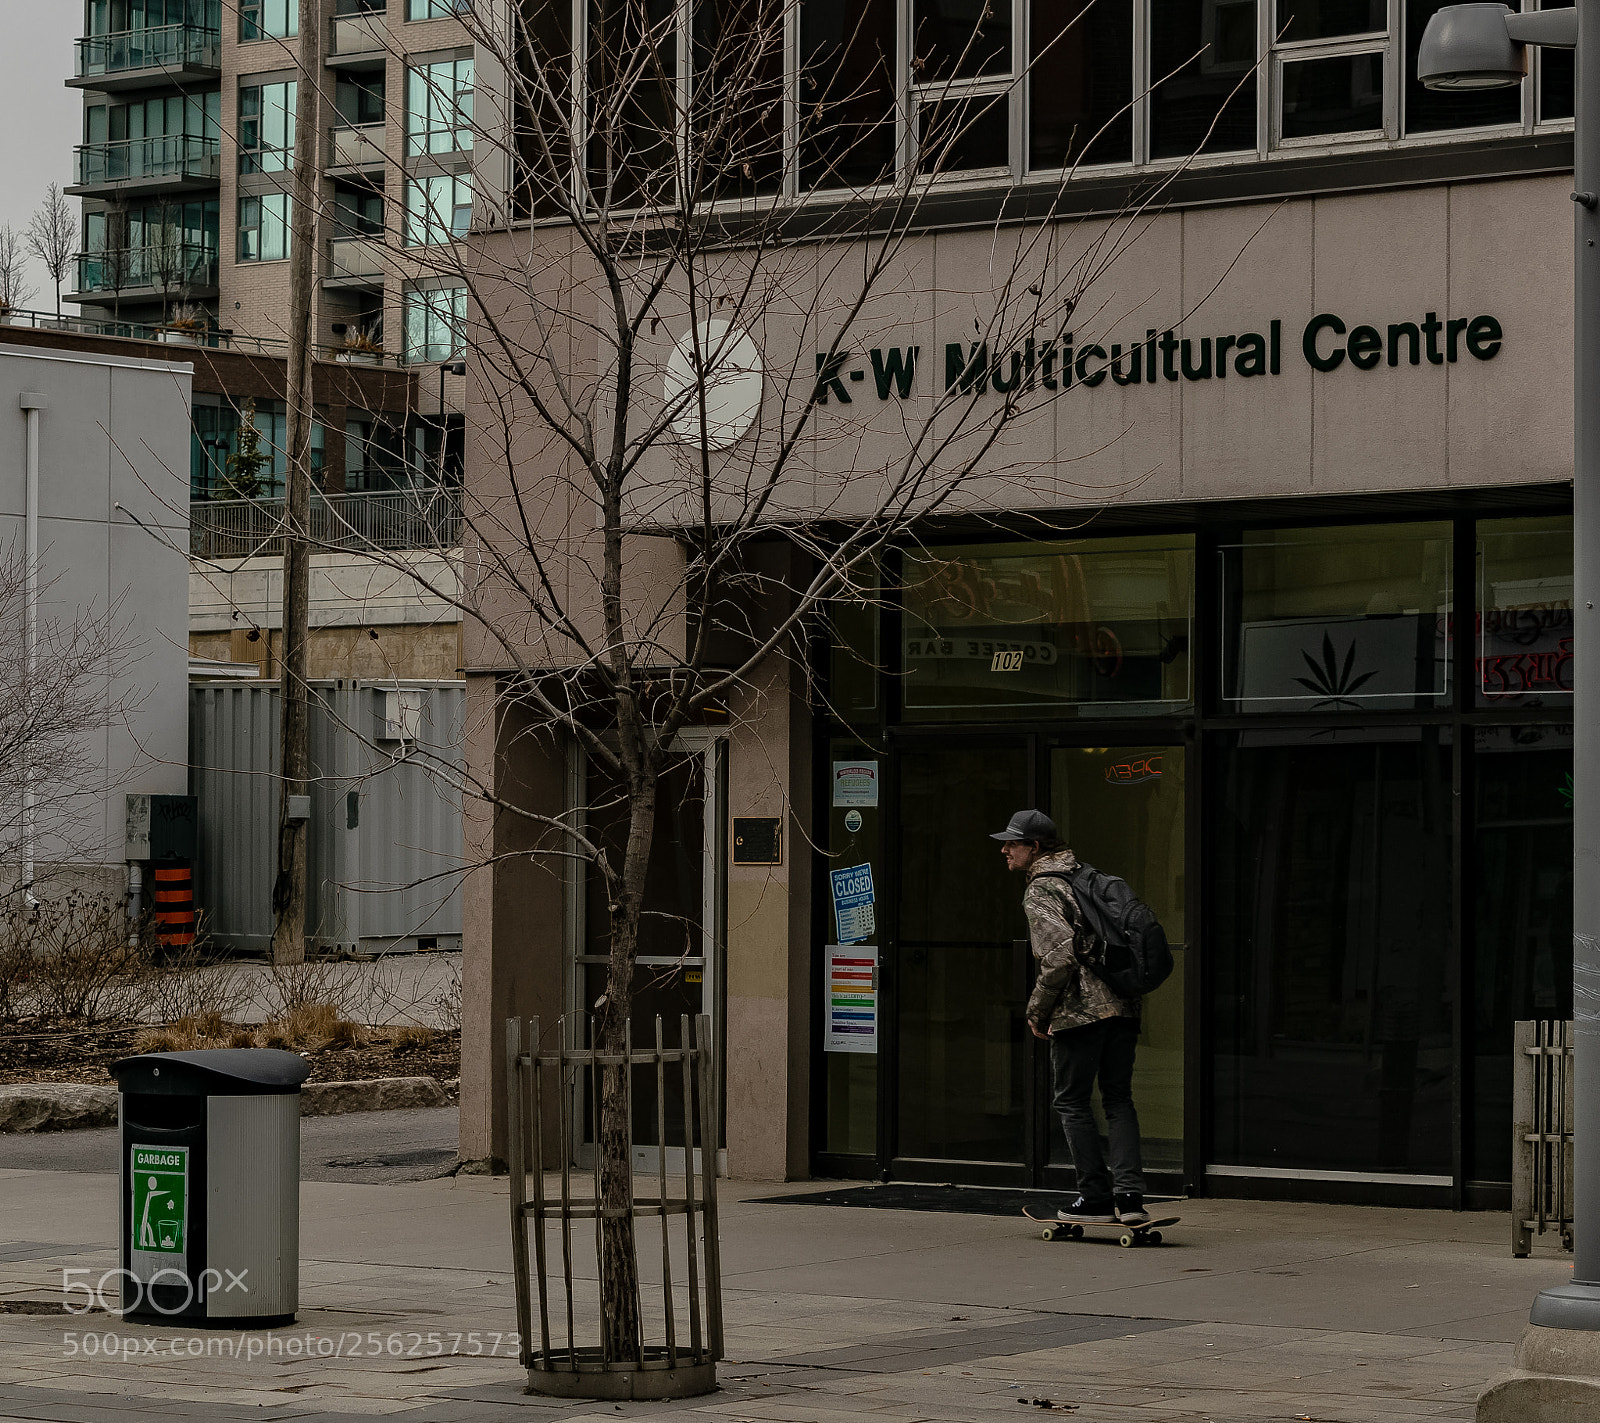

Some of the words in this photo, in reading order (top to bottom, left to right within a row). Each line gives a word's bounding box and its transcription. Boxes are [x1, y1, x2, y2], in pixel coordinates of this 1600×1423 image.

[815, 346, 920, 404] K-W
[945, 319, 1281, 396] Multicultural
[1302, 311, 1503, 372] Centre
[994, 652, 1022, 670] 102
[834, 871, 854, 881] SORRY
[835, 875, 871, 897] CLOSED
[137, 1152, 180, 1166] GARBAGE
